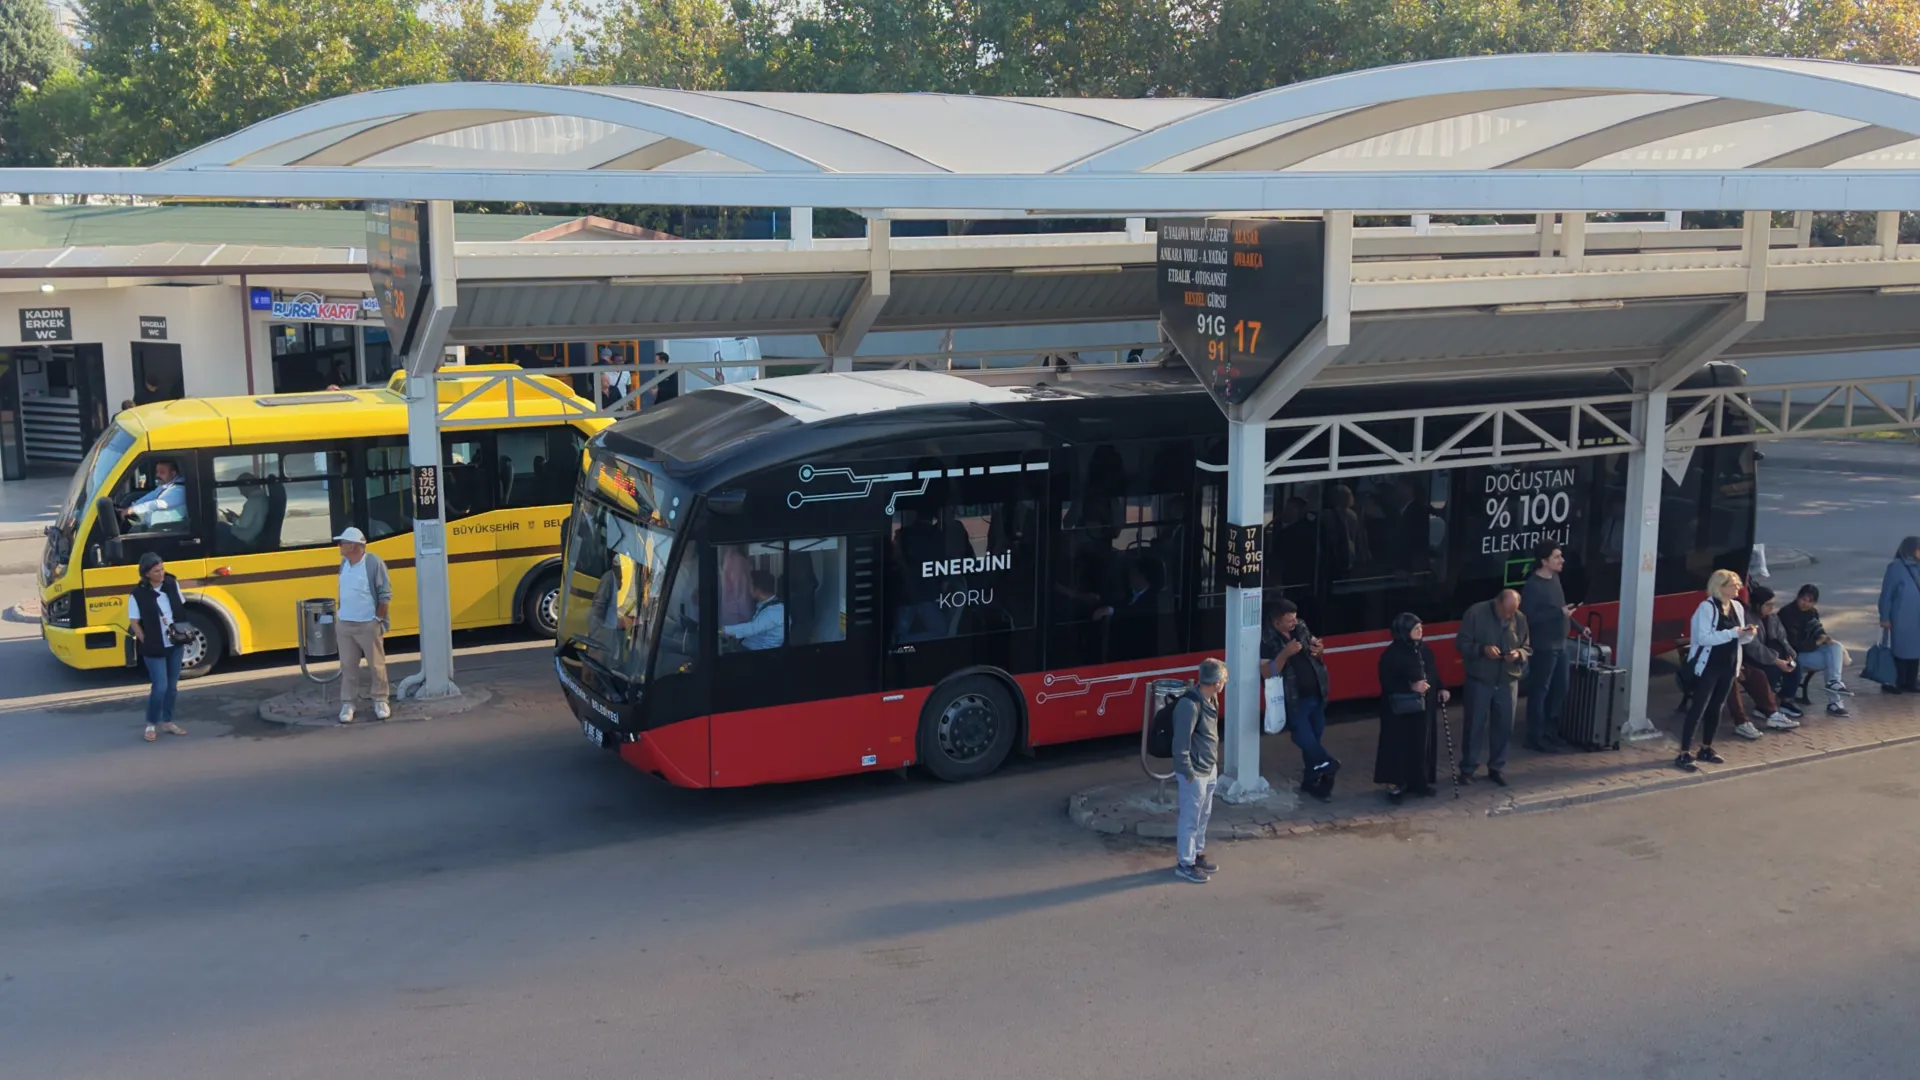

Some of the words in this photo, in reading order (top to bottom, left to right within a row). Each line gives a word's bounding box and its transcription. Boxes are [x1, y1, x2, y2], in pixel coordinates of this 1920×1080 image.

[1209, 228, 1228, 243] ZAFER
[1160, 247, 1182, 261] ANKARA
[1183, 248, 1199, 263] YOLU
[1168, 268, 1191, 284] ETBALIK
[394, 288, 405, 319] 38
[1207, 291, 1227, 309] GÜRSU
[25, 310, 64, 319] KADIN
[273, 302, 358, 319] BURSAKART
[25, 319, 65, 328] ERKEK
[141, 320, 166, 328] ENGELLİ
[1197, 313, 1226, 337] 91G
[35, 330, 57, 339] WC
[1233, 319, 1262, 354] 17
[1208, 340, 1224, 362] 91
[421, 467, 434, 477] 38
[418, 477, 435, 486] 17E
[1485, 468, 1575, 494] DOĞUŞTAN
[419, 486, 436, 495] 17Y
[420, 495, 437, 505] 18Y
[453, 521, 520, 536] BÜYÜKŞEHİR
[543, 519, 562, 529] BEL
[1246, 528, 1257, 539] 17
[1230, 529, 1237, 540] 17
[1227, 540, 1236, 552] 91
[1244, 540, 1255, 552] 91
[1227, 553, 1241, 566] 91G
[1245, 550, 1262, 563] 91G
[922, 549, 1012, 578] ENERJİNİ
[1242, 564, 1260, 574] 17H
[1226, 565, 1240, 576] 17H
[938, 588, 994, 609] KORU
